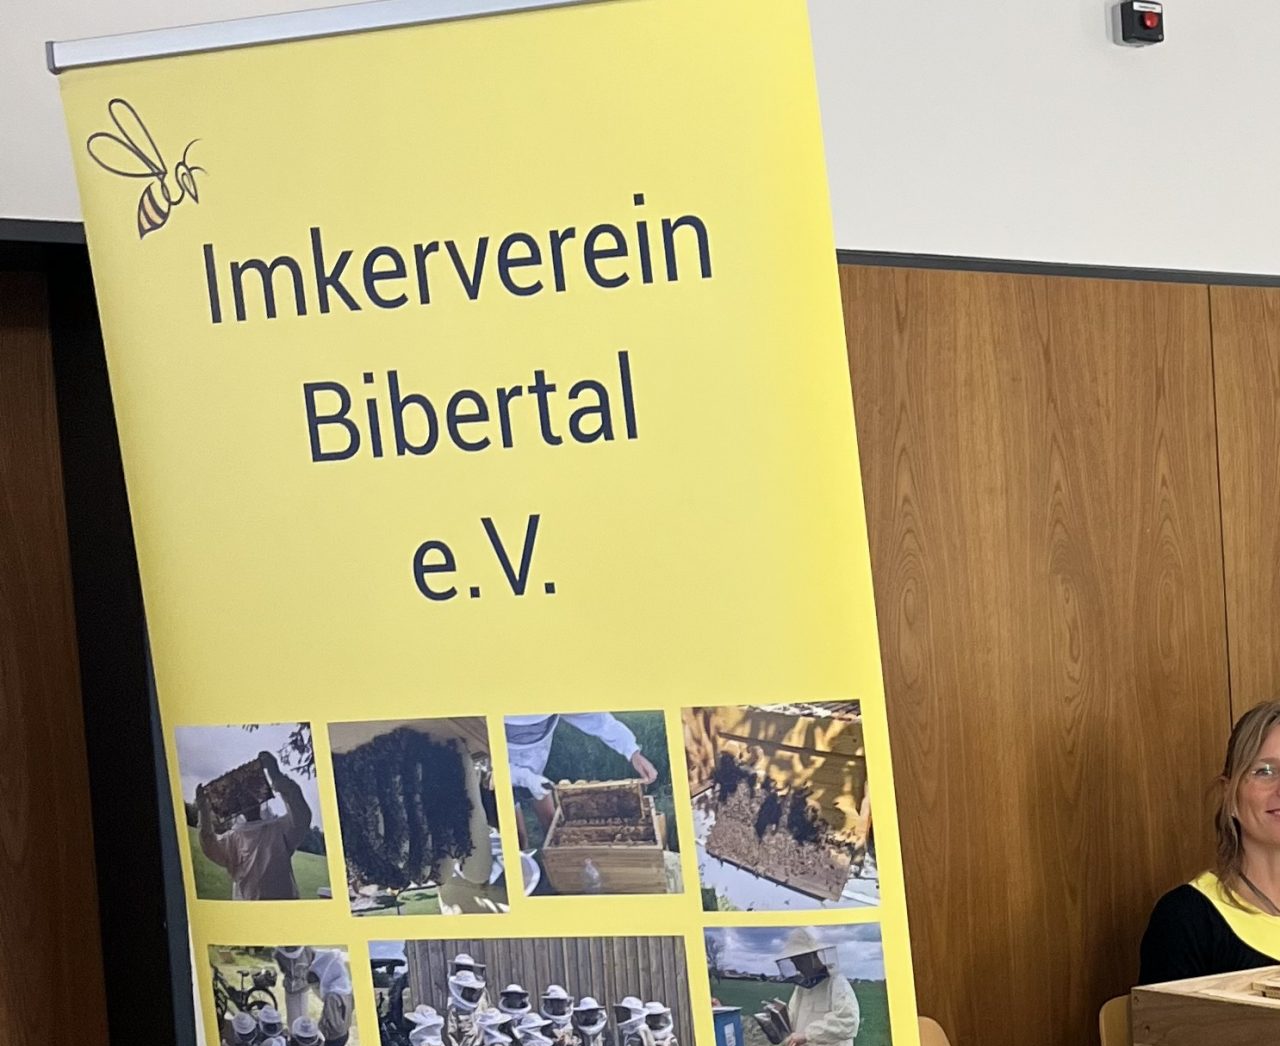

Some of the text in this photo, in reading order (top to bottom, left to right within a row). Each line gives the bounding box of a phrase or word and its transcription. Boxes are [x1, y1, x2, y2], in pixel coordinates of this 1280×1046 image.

[202, 193, 712, 324] Imkerverein
[302, 350, 639, 463] Bibertal
[412, 514, 556, 602] e.V.
